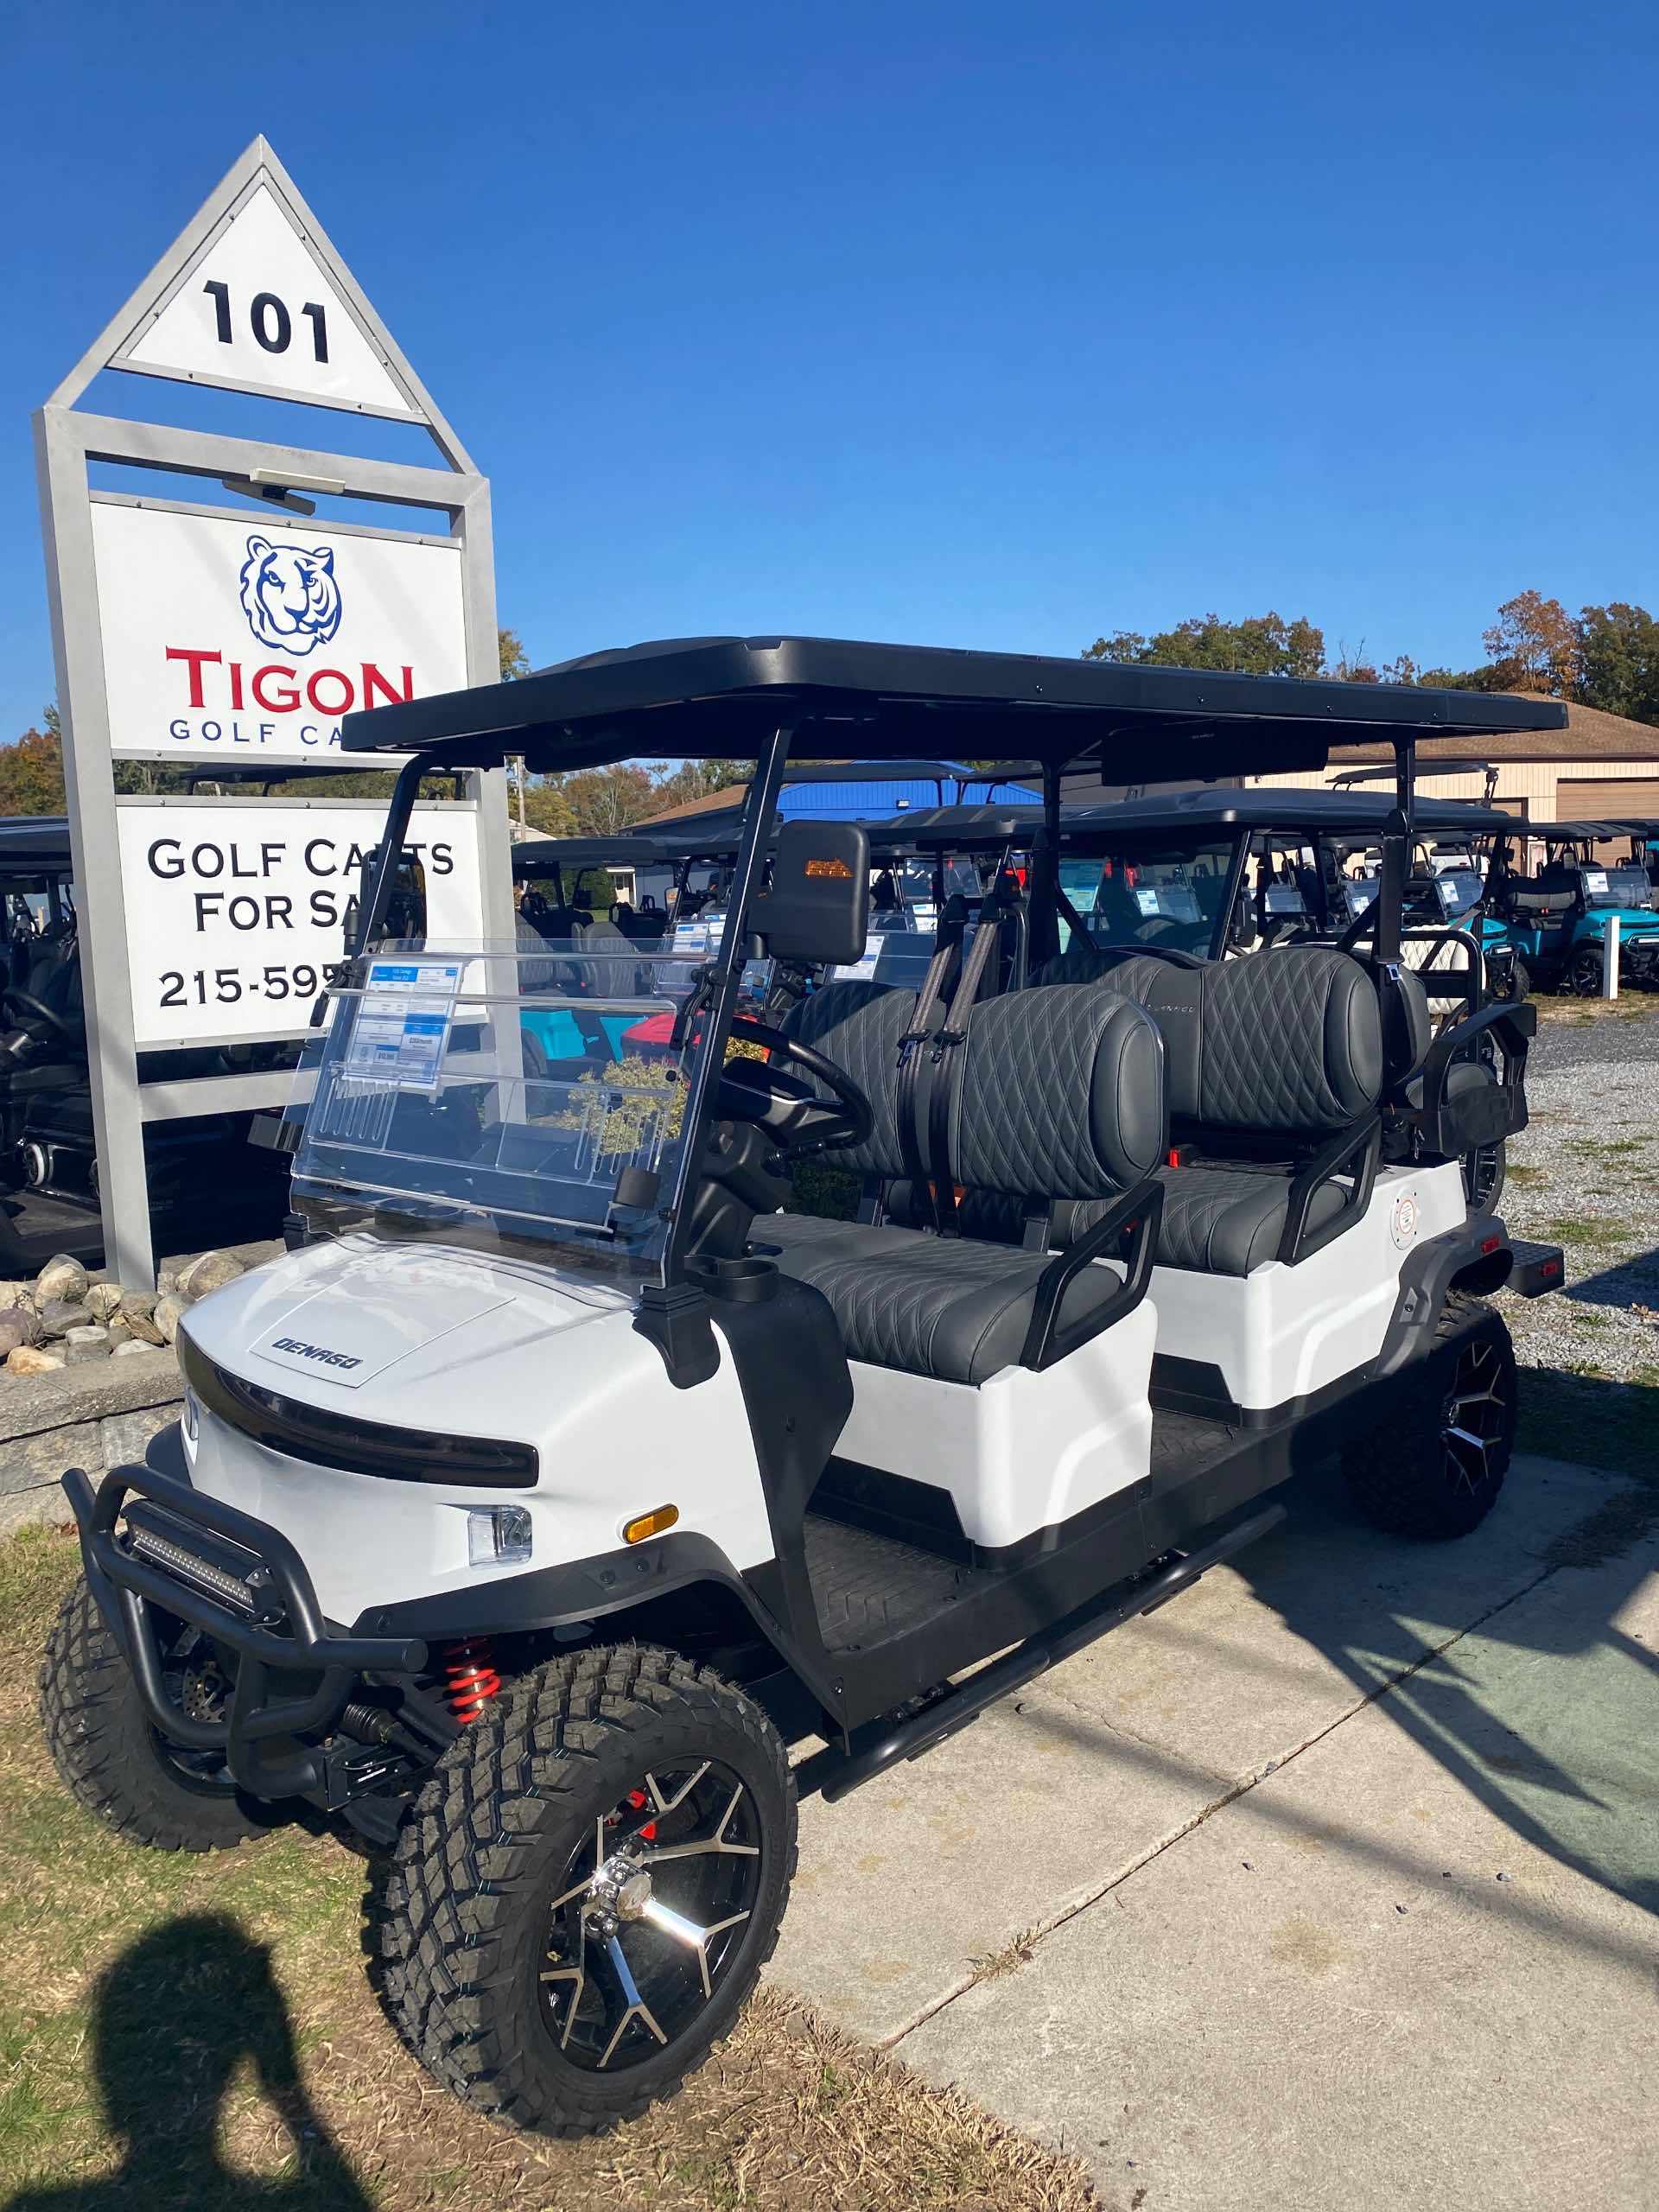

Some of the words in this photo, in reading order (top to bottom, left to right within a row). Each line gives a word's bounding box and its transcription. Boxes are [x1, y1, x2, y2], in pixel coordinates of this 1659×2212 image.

[202, 280, 328, 364] 101
[166, 645, 414, 716] TIGON
[169, 719, 276, 743] GOLF
[147, 838, 287, 880] GOLF
[194, 892, 296, 931] FOR
[271, 1338, 363, 1370] DENAGO
